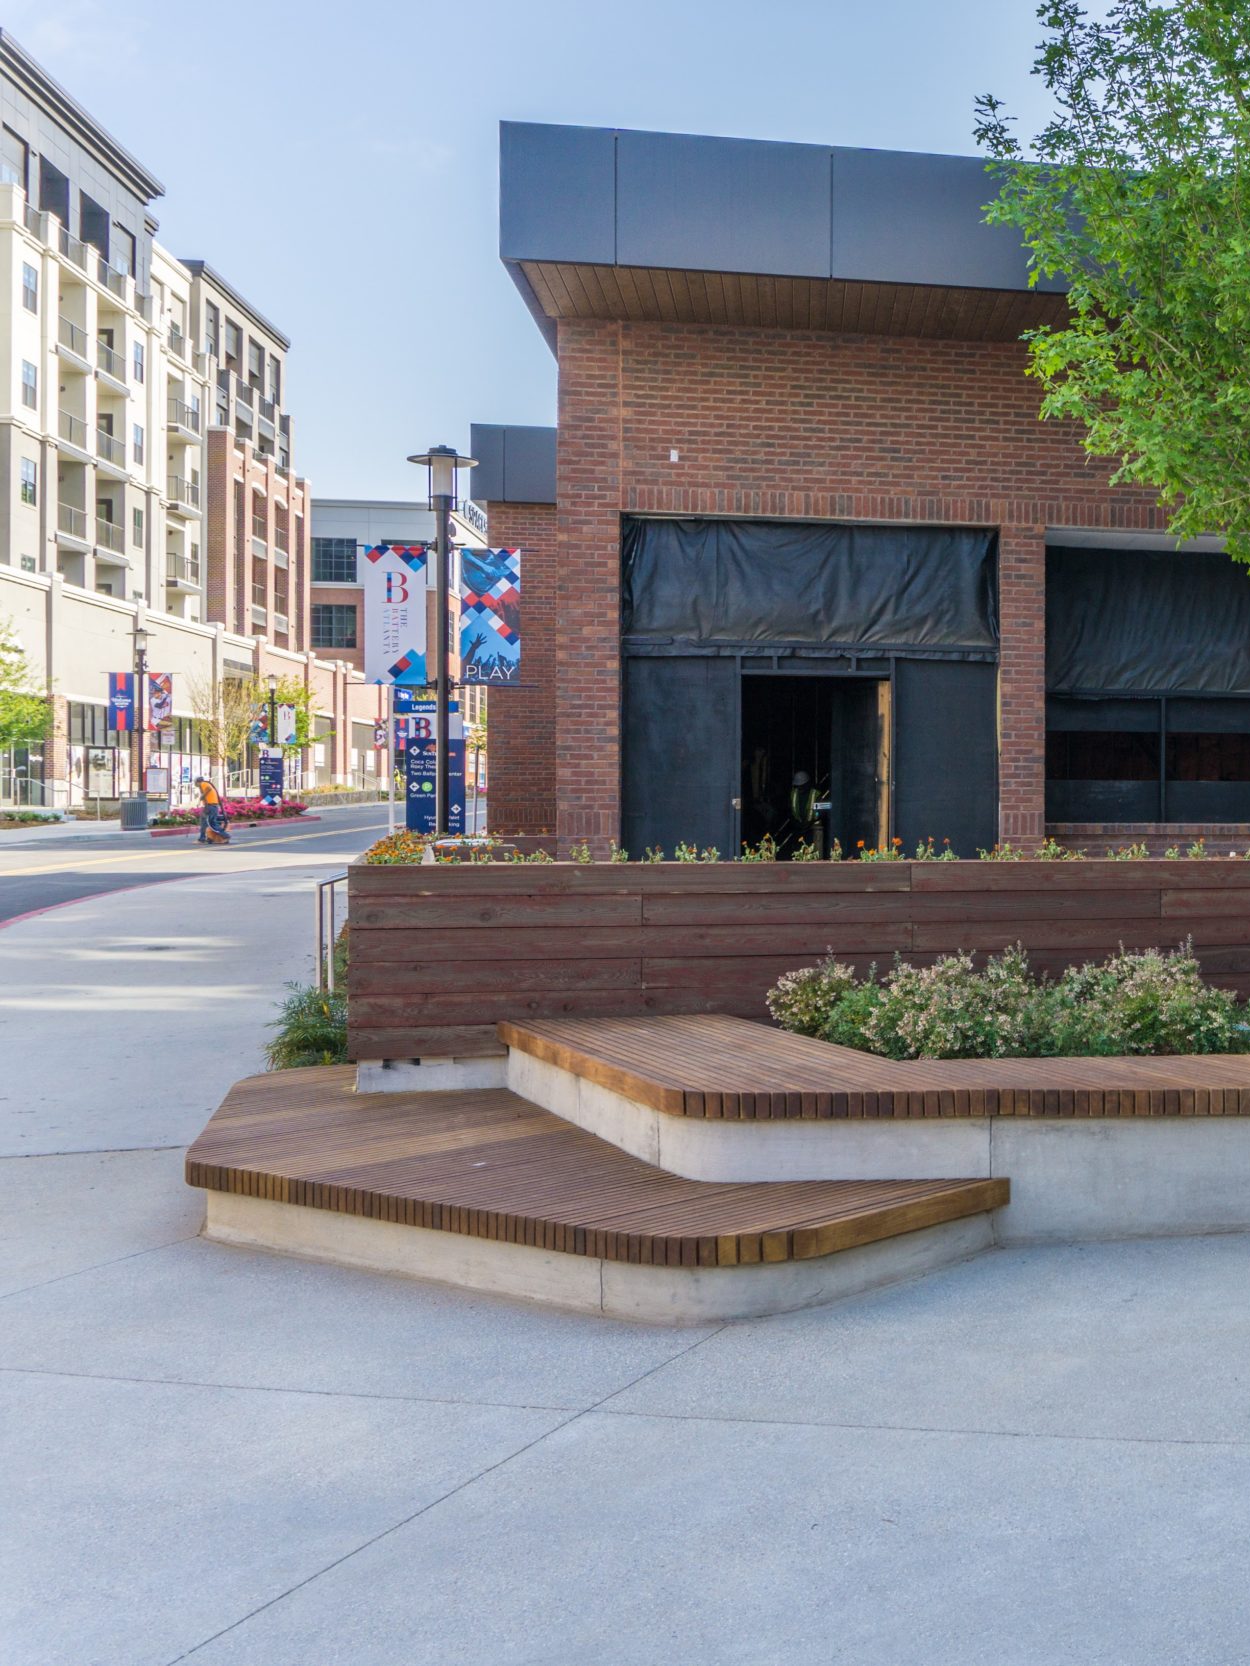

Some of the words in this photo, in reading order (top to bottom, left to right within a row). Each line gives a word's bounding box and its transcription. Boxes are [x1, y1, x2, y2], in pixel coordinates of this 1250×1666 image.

[381, 571, 409, 604] B
[466, 664, 515, 680] PLAY
[411, 703, 437, 712] Legends
